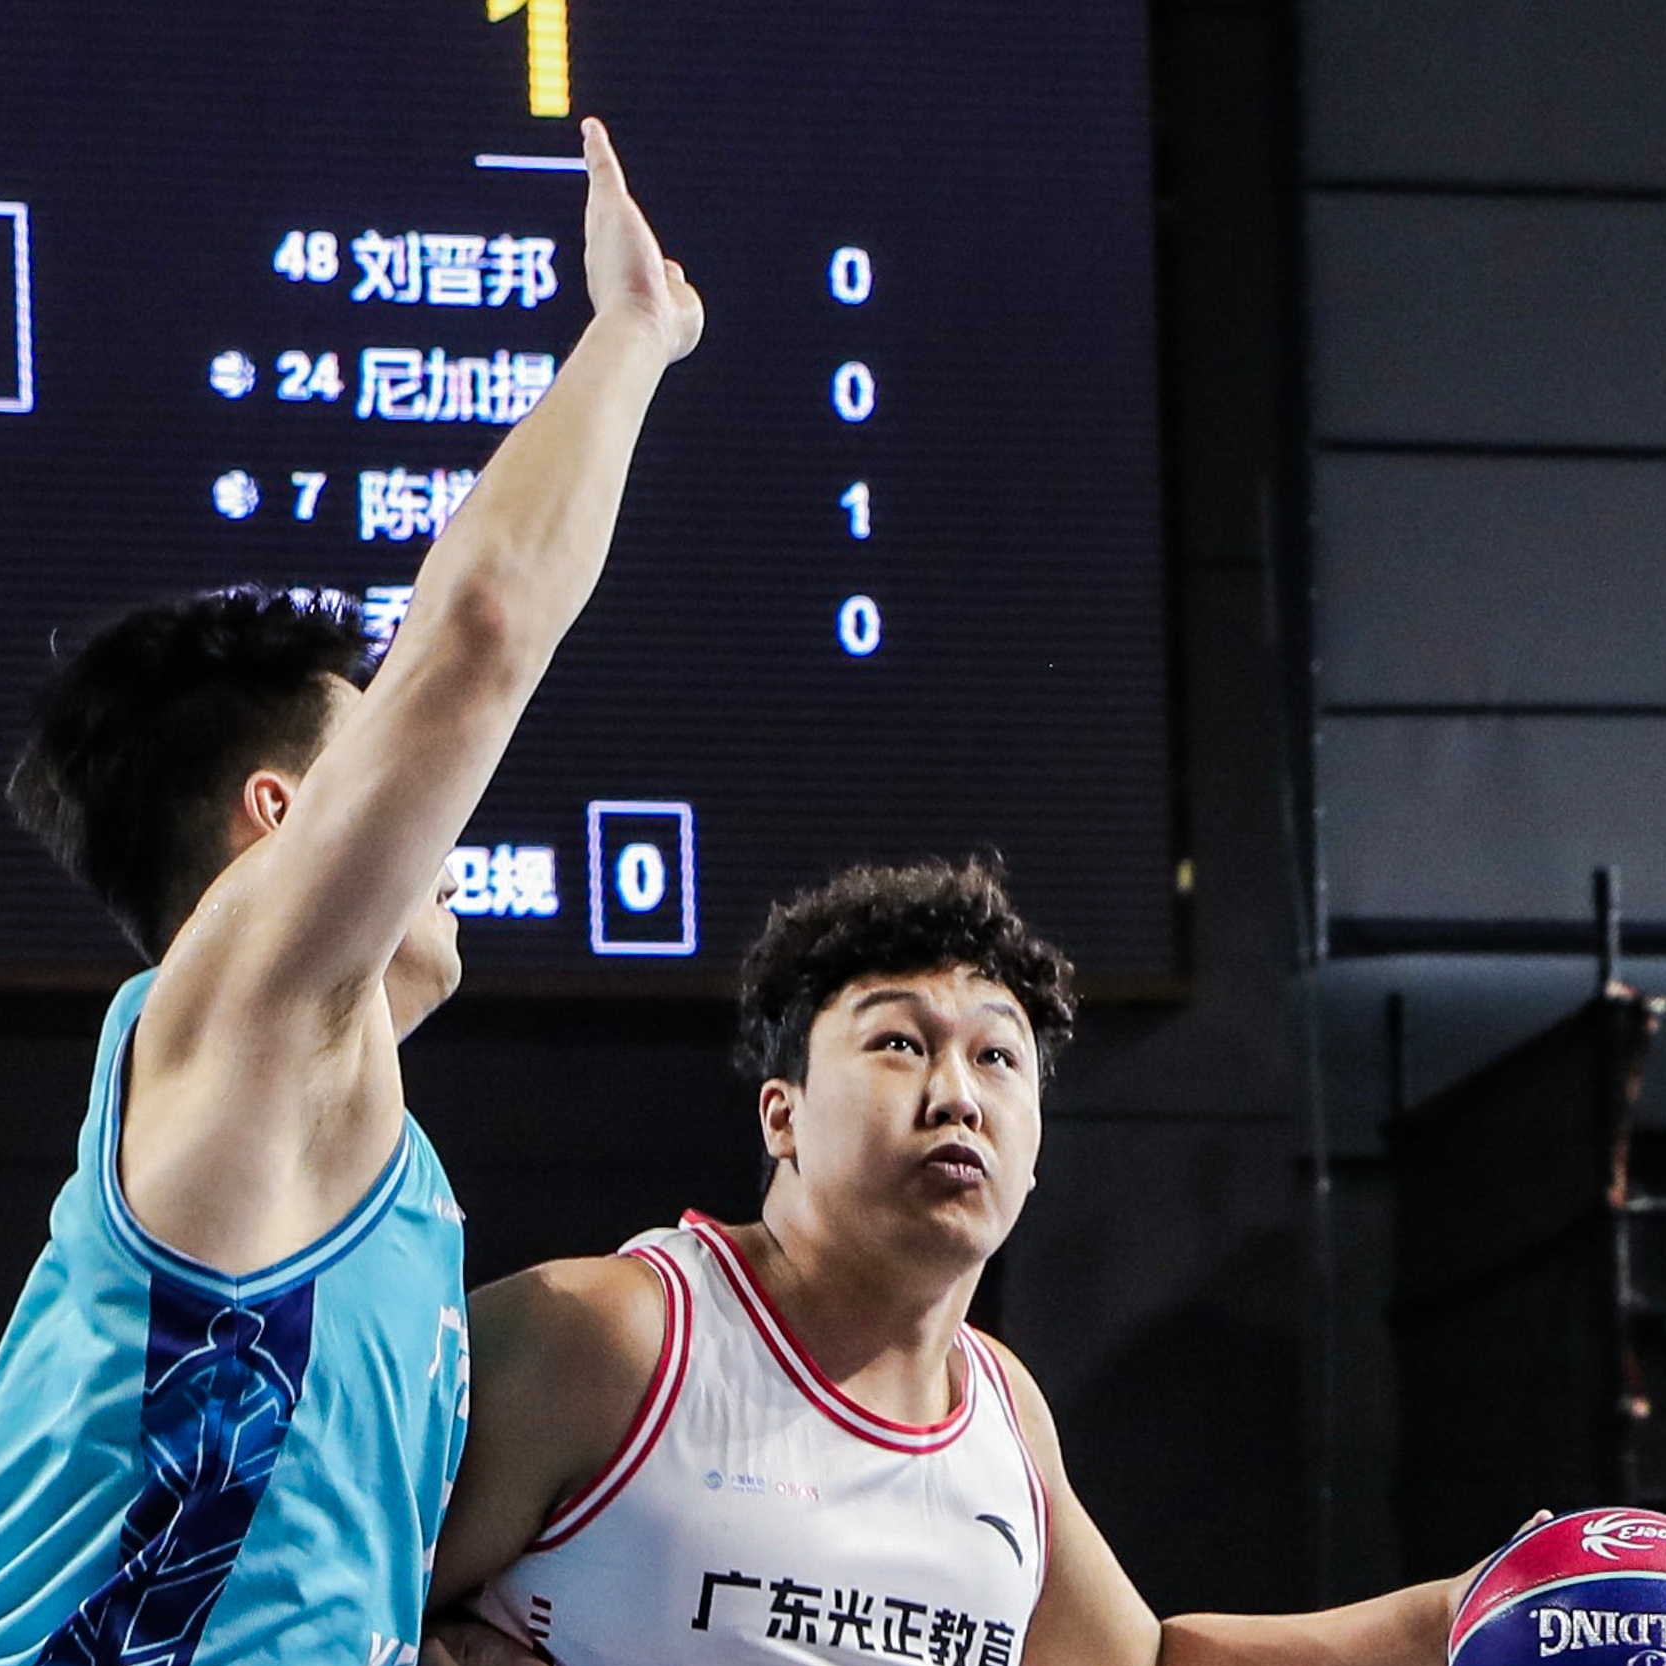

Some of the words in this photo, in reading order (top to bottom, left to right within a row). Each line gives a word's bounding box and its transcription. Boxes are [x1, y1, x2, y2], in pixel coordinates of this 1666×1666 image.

[274, 230, 339, 281] 48
[351, 229, 559, 308] 刘晋邦
[831, 247, 872, 303] 0
[276, 350, 344, 400] 24
[834, 361, 876, 421] 0
[291, 471, 327, 520] 7
[840, 481, 871, 538] 1
[838, 595, 881, 655] 0
[616, 842, 665, 912] 0
